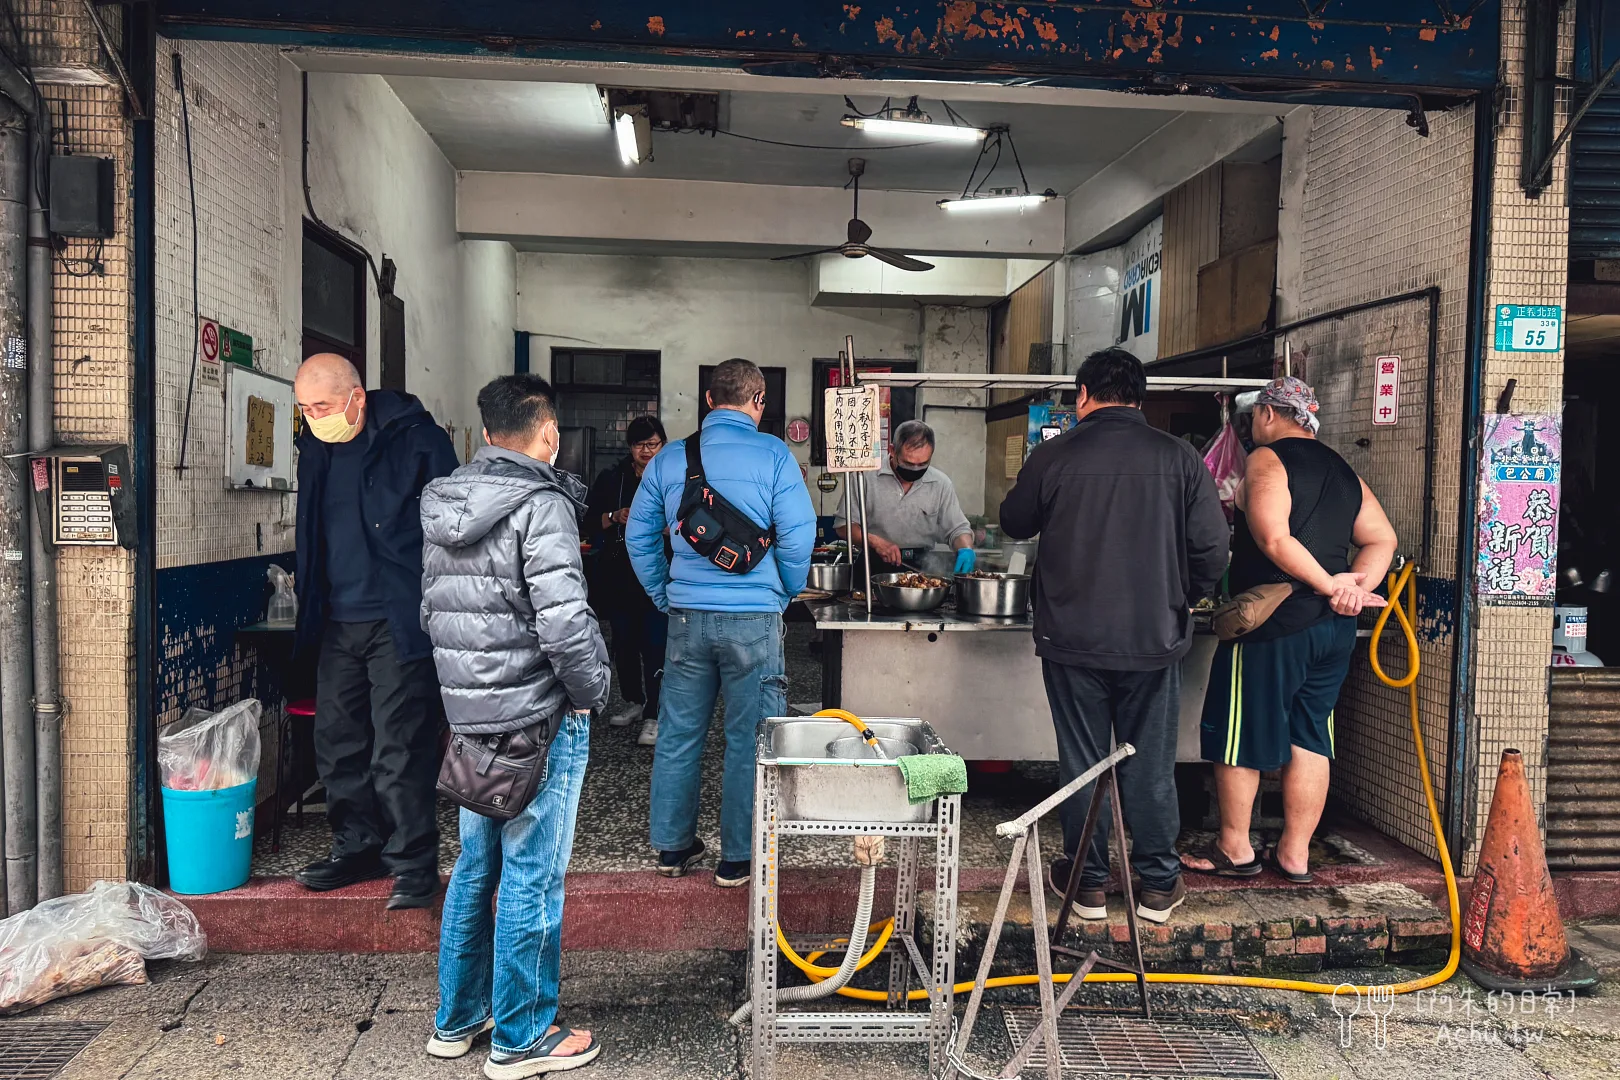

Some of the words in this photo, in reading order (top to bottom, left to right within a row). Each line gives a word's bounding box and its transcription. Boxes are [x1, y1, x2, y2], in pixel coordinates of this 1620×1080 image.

[1123, 250, 1162, 291] EDIACARD
[1516, 306, 1557, 317] 正義北路
[1524, 330, 1546, 346] 55
[1379, 361, 1395, 419] 營業中
[845, 397, 859, 460] 因人力不足
[1505, 467, 1545, 480] 包公廟
[1522, 488, 1556, 560] 恭賀
[1487, 521, 1522, 591] 新禧
